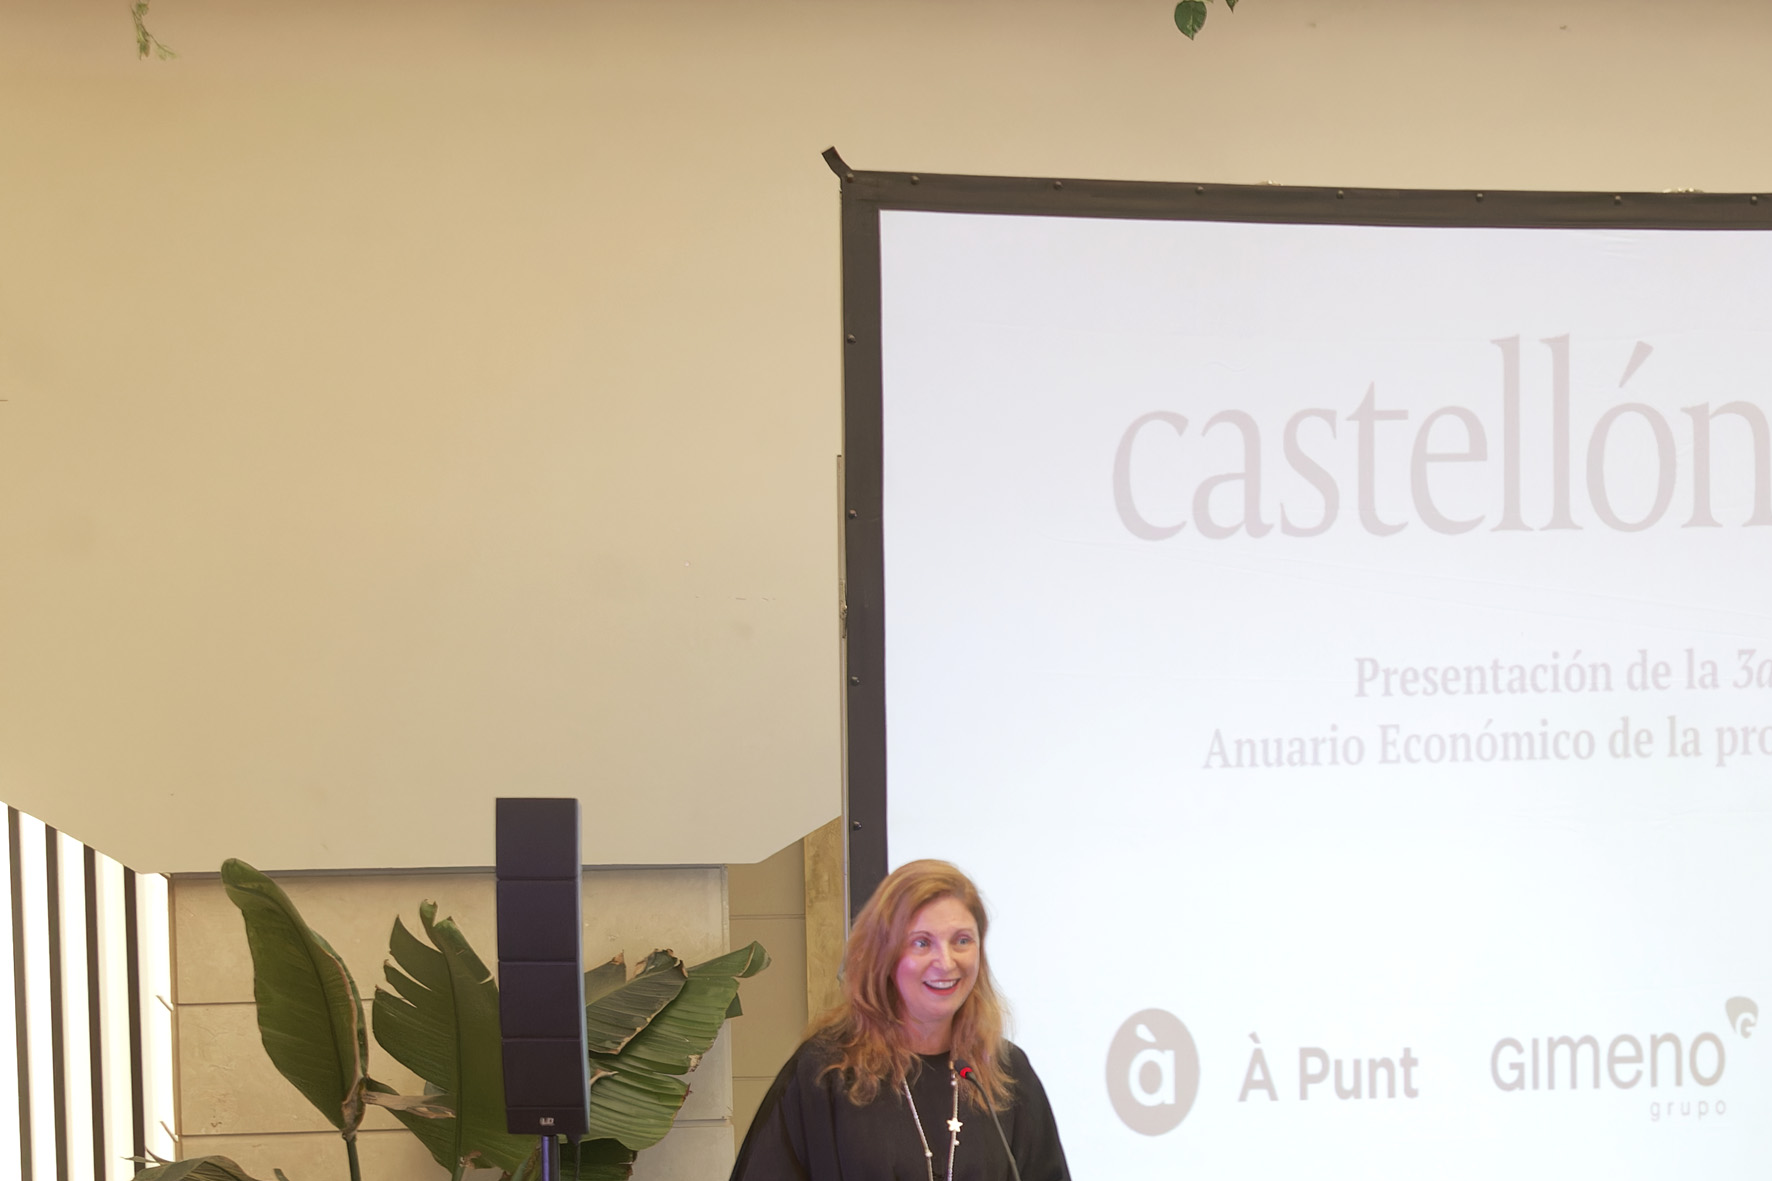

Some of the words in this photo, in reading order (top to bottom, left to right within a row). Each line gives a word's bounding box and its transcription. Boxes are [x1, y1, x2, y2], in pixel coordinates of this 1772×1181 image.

[1353, 648, 1615, 698] Presentación
[1625, 649, 1673, 692] de
[1684, 647, 1721, 690] la
[1202, 723, 1366, 770] Anuario
[1377, 718, 1596, 765] Económico
[1608, 716, 1655, 759] de
[1666, 715, 1703, 758] la
[1238, 1031, 1280, 1103] À
[1297, 1046, 1420, 1102] Punt
[1649, 1098, 1728, 1122] grupo
